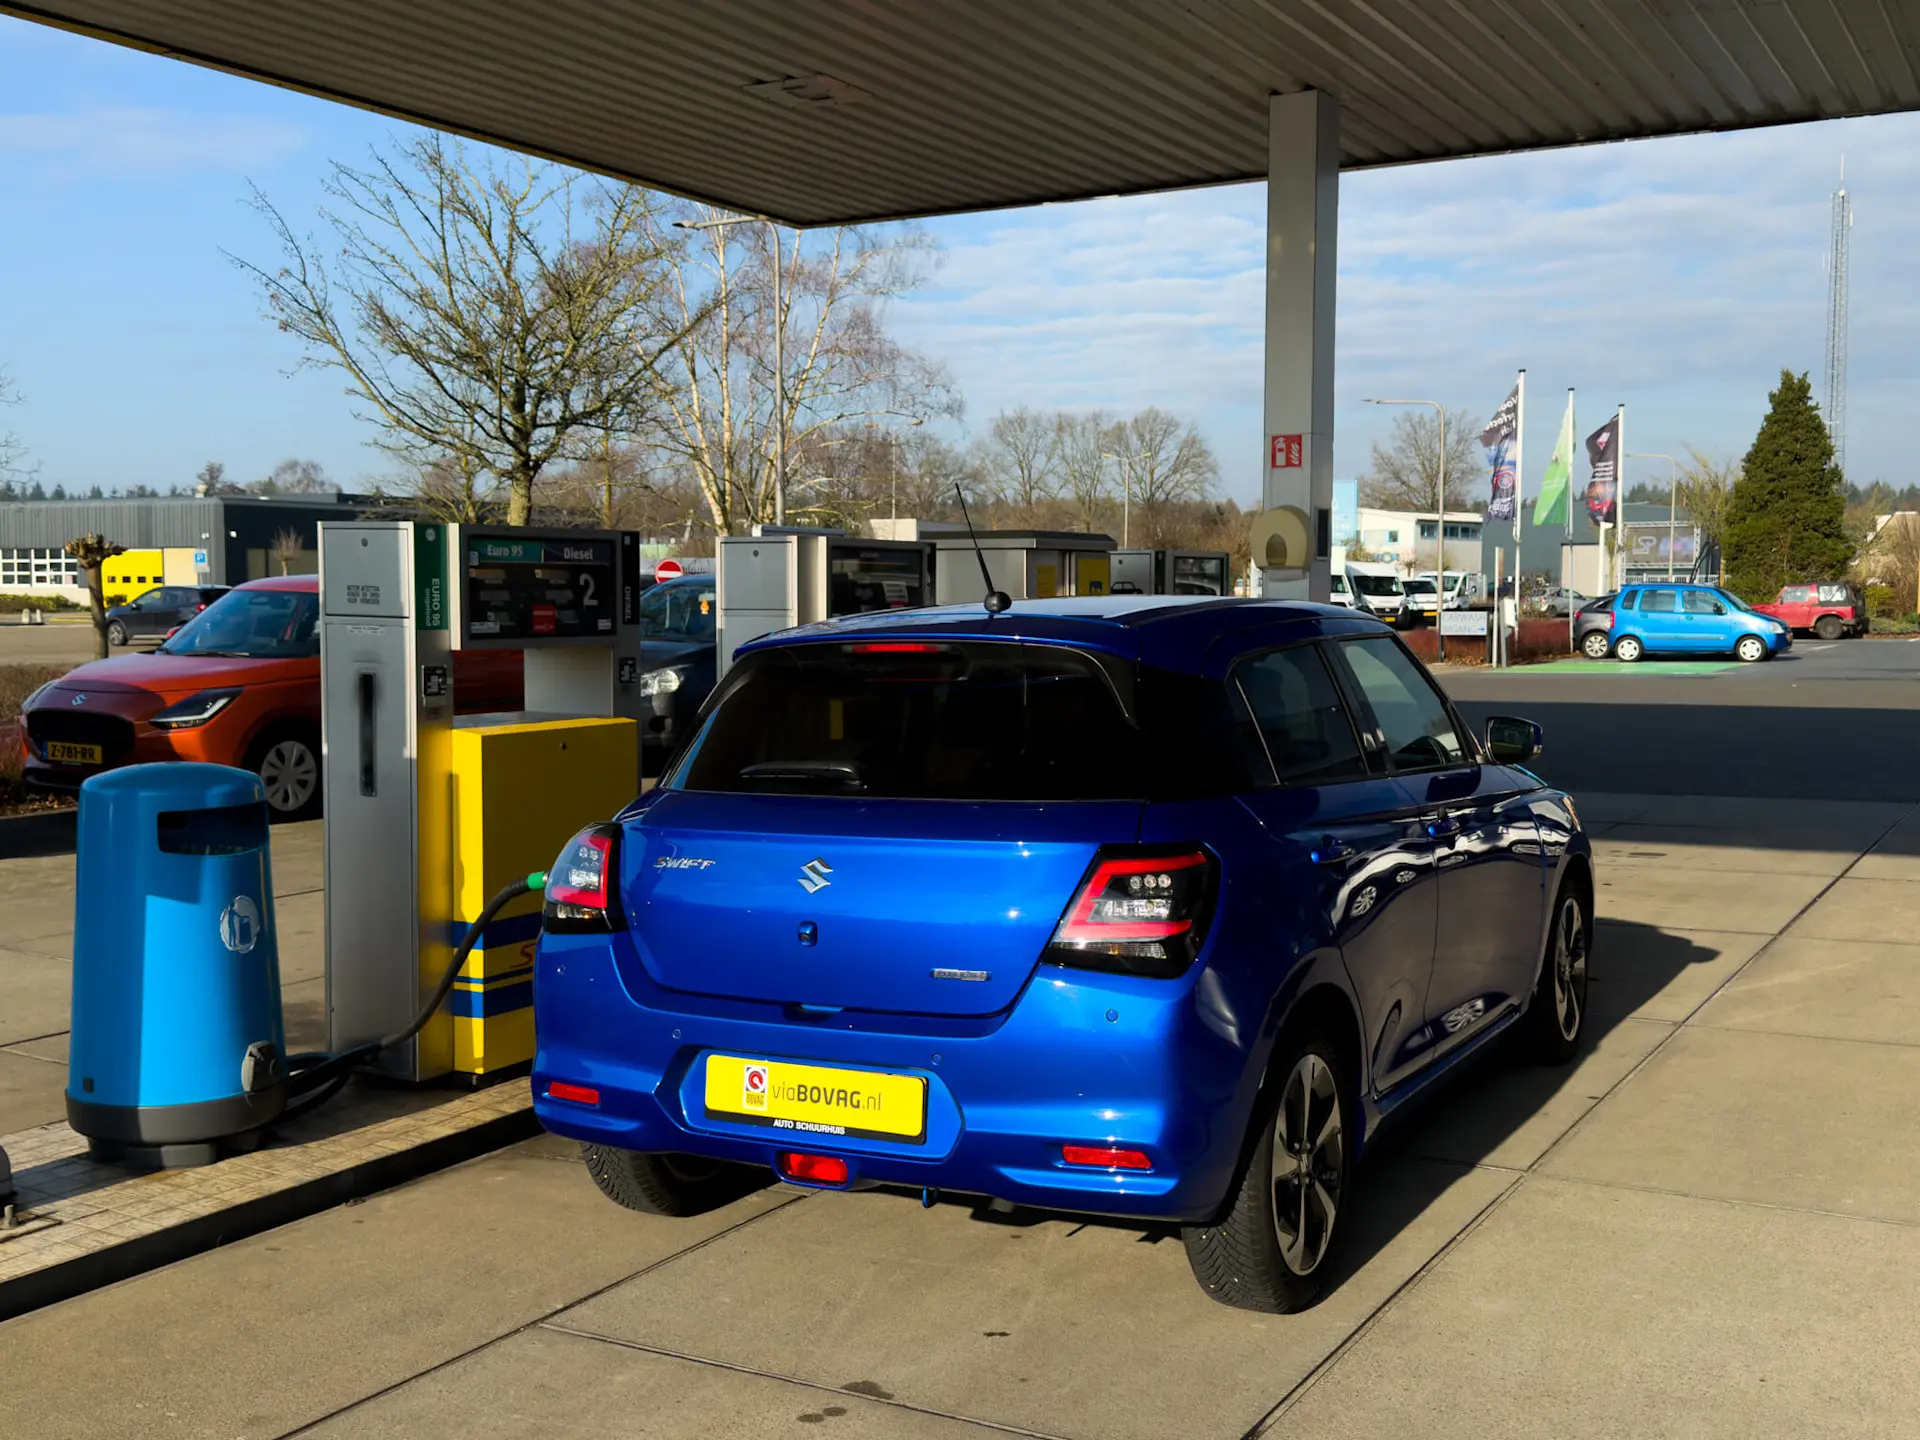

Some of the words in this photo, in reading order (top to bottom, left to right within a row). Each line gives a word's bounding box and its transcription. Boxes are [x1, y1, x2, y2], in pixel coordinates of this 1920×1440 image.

[487, 544, 509, 557] Euro
[511, 545, 524, 557] 95
[564, 547, 593, 560] Diesel
[431, 578, 440, 610] EURO
[579, 573, 599, 606] 2
[431, 613, 440, 626] 95
[653, 856, 716, 870] SWIFT
[746, 1093, 764, 1105] BOVAG
[771, 1081, 882, 1111] viaBOVAG.nl
[773, 1118, 794, 1129] AUTO
[795, 1121, 846, 1135] SCHUURHUIS
